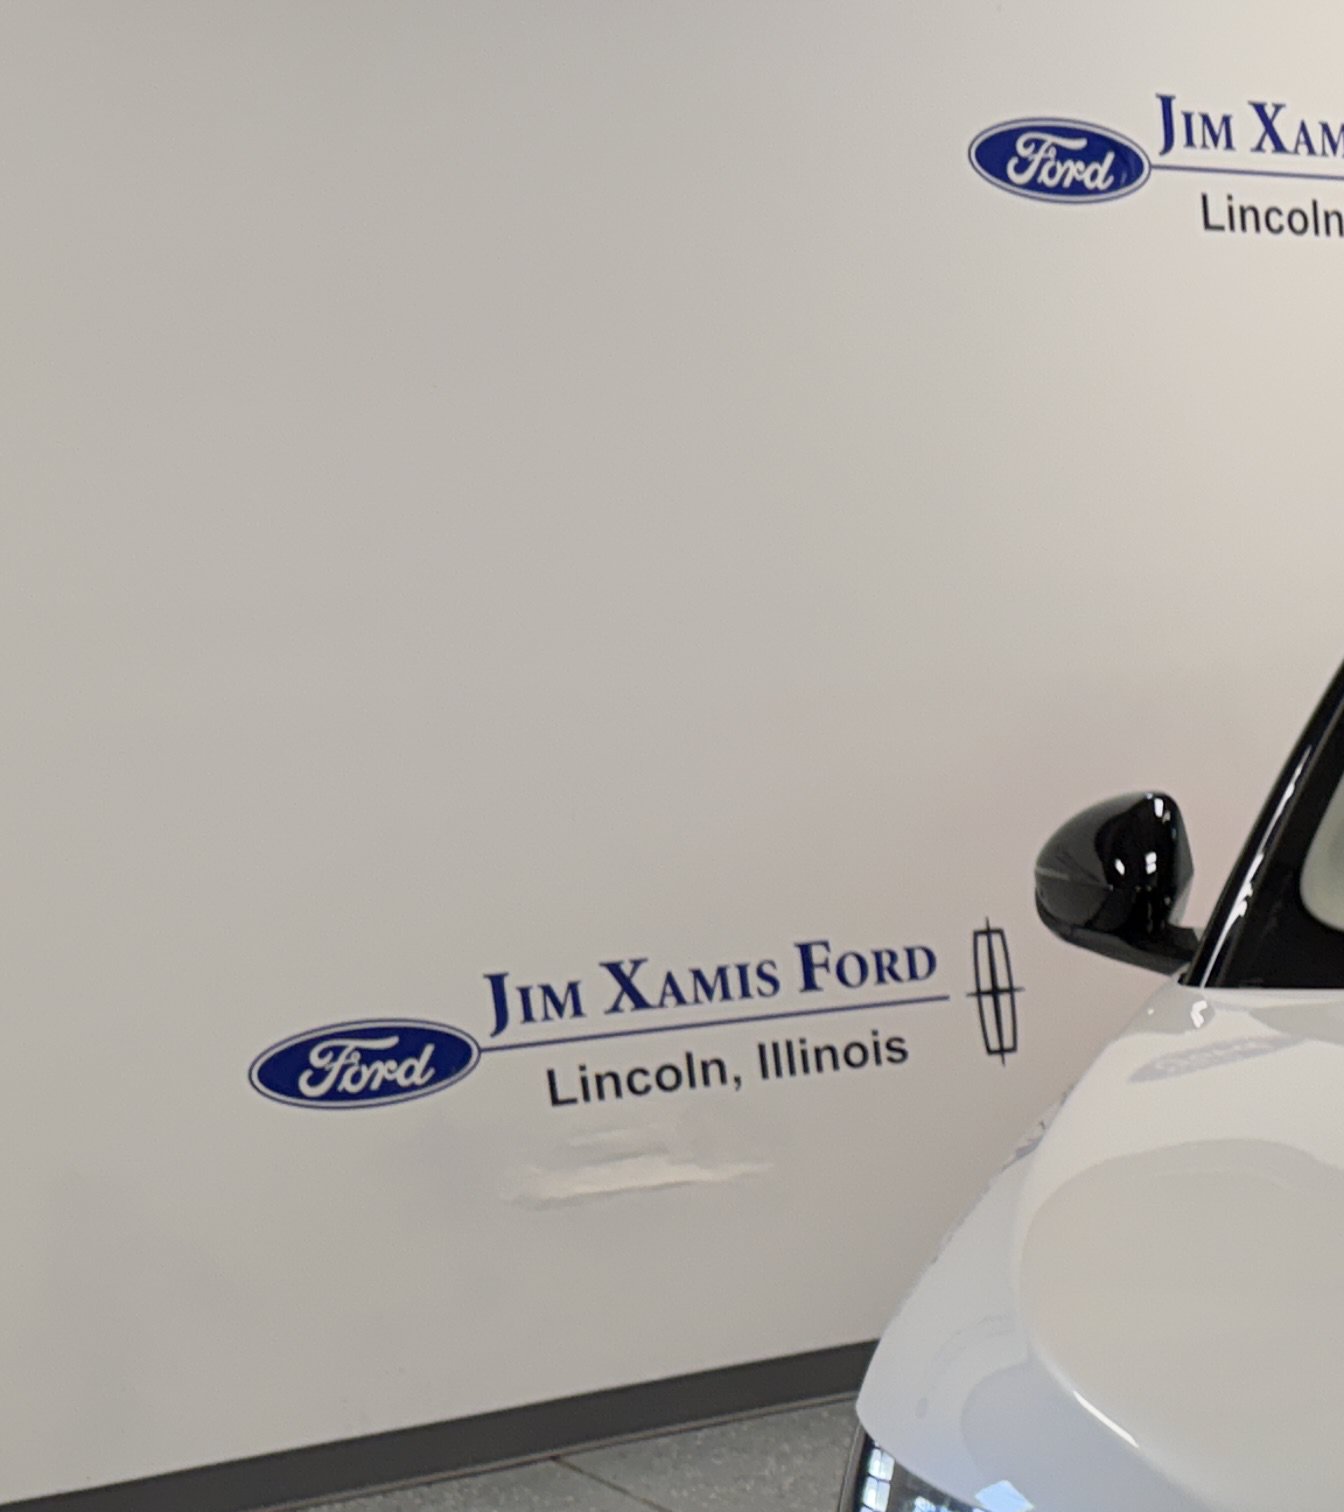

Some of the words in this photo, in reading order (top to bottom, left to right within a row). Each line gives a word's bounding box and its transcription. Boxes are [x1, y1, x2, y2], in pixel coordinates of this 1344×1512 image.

[1154, 93, 1236, 157] JIM
[1006, 131, 1115, 191] Ford
[482, 970, 586, 1039] JIM
[598, 957, 782, 1015] XAMIS
[793, 938, 938, 993] FORD
[297, 1036, 435, 1098] Ford
[546, 1051, 743, 1108] Lincoln,
[757, 1029, 910, 1081] Illinois
